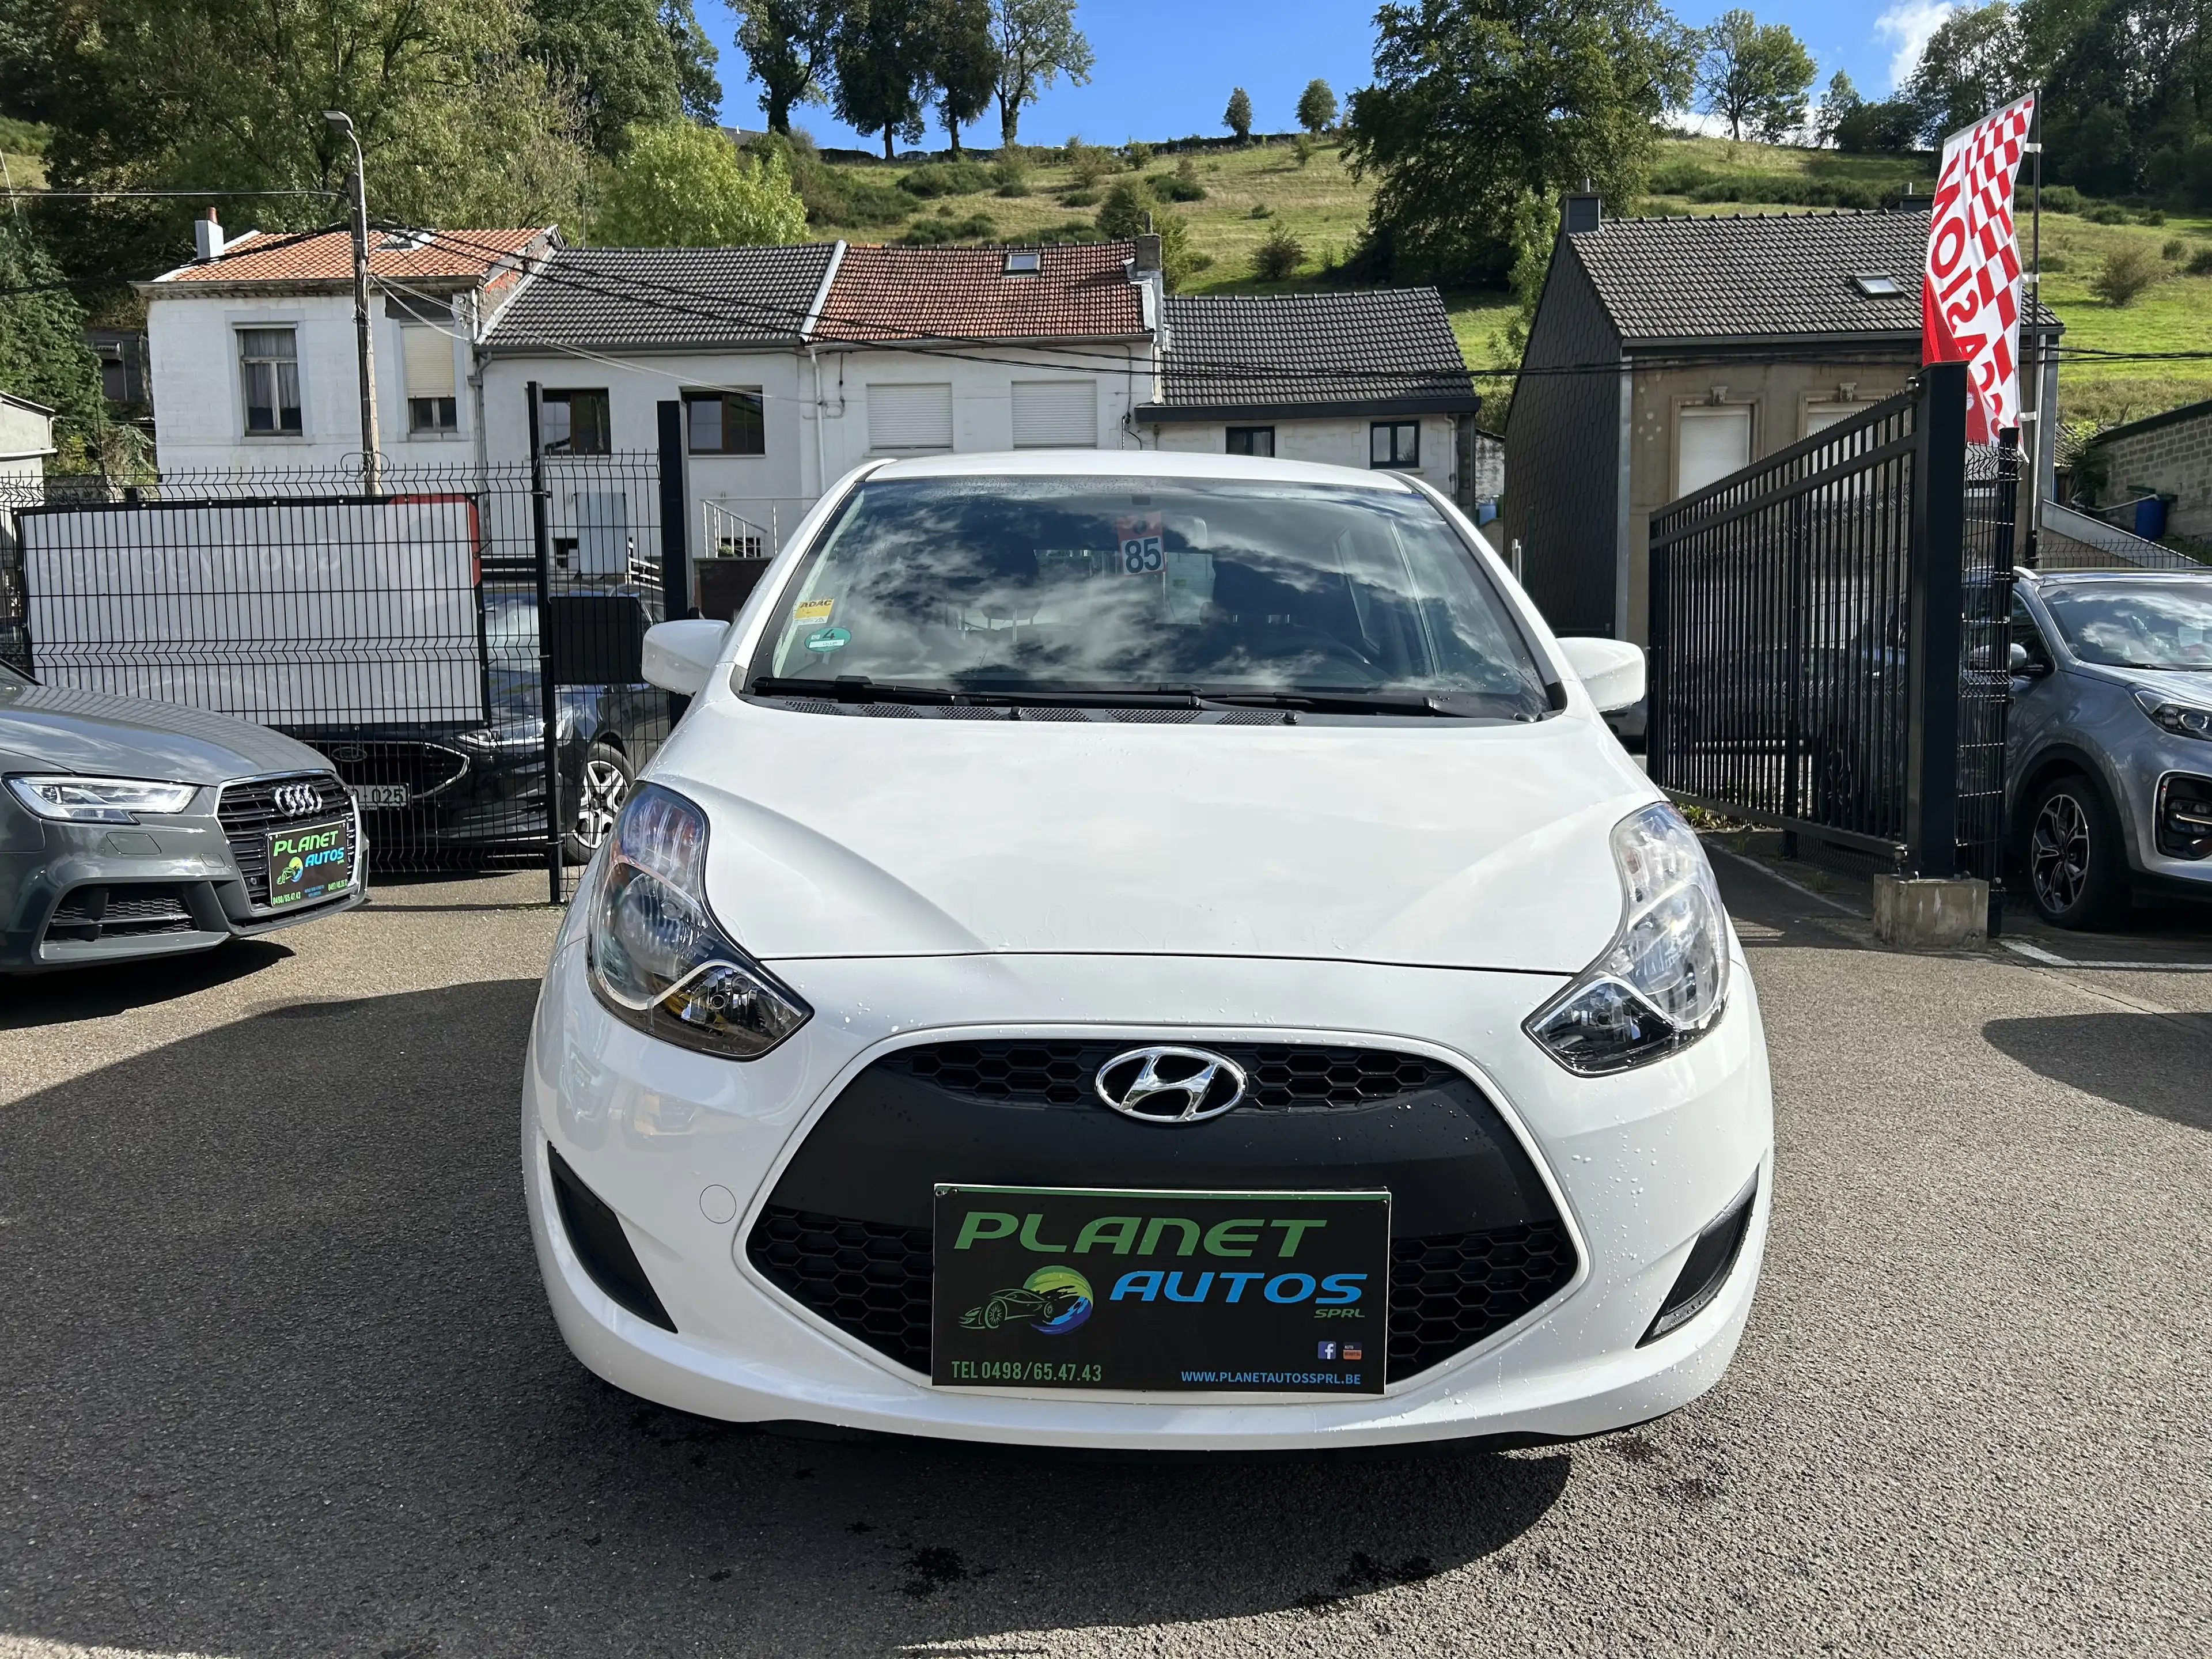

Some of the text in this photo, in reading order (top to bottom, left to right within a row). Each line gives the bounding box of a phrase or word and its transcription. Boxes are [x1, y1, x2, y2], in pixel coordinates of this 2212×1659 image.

[1125, 537, 1161, 574] 85
[800, 599, 832, 608] ADAC
[822, 628, 835, 639] 4
[273, 830, 339, 857] PLANET
[305, 847, 344, 868] AUTOS
[953, 1211, 1327, 1258] PLANET
[1109, 1270, 1368, 1305] AUTOS
[1314, 1308, 1365, 1318] SPRL
[951, 1361, 1102, 1381] TEL 0498/65.47.43
[1181, 1371, 1361, 1385] WWW.PLANETAUTOSSPRL.BE
